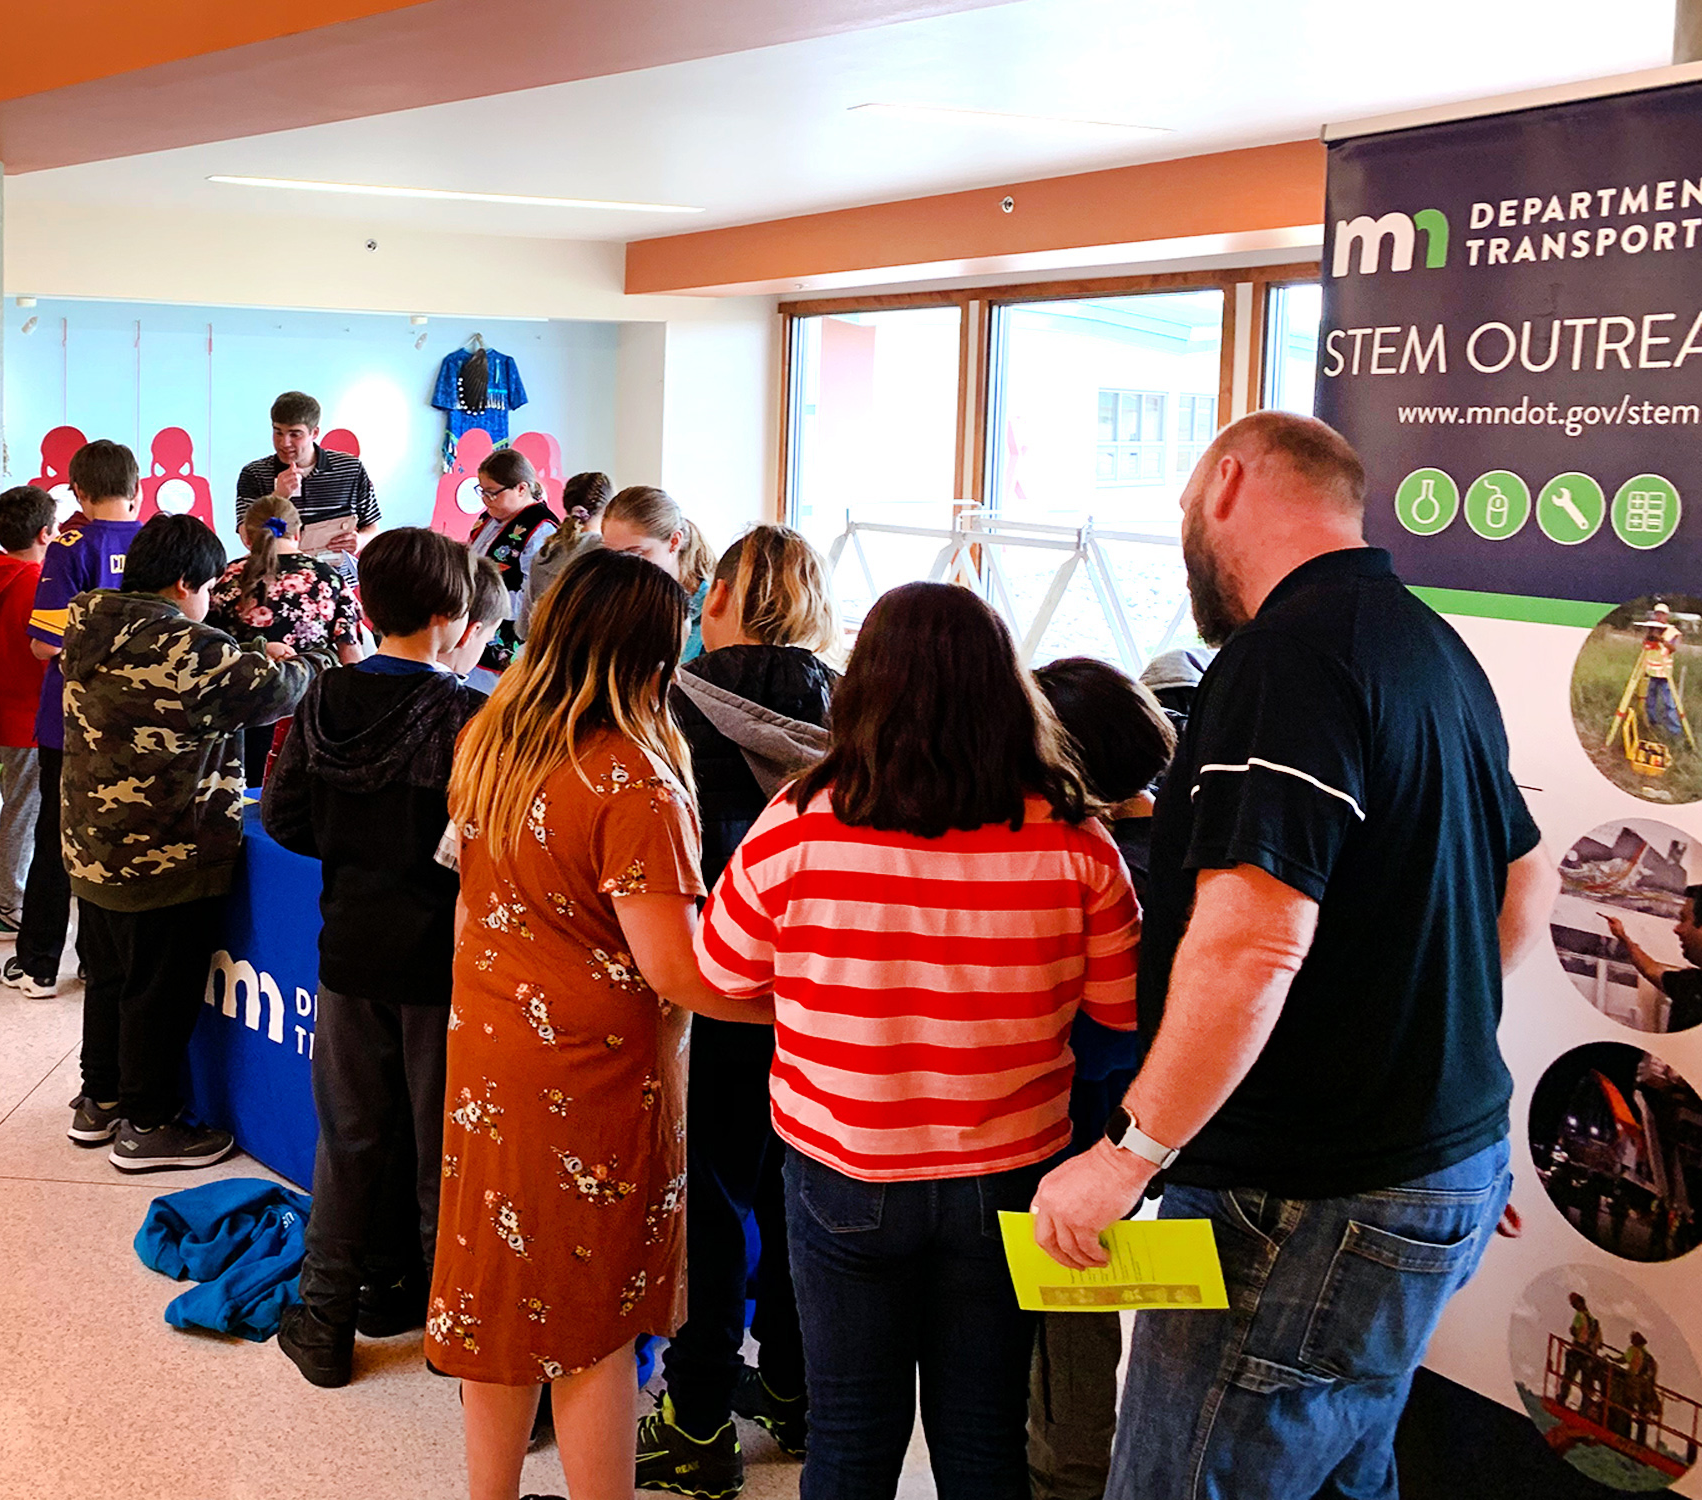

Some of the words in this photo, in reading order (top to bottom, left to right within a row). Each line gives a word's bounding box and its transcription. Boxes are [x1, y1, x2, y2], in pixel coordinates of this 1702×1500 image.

[1469, 177, 1702, 230] DEPARTMEN
[1466, 219, 1702, 266] TRANSPORT
[1323, 323, 1447, 377] STEM
[1398, 394, 1700, 437] www.mndot.gov/stem
